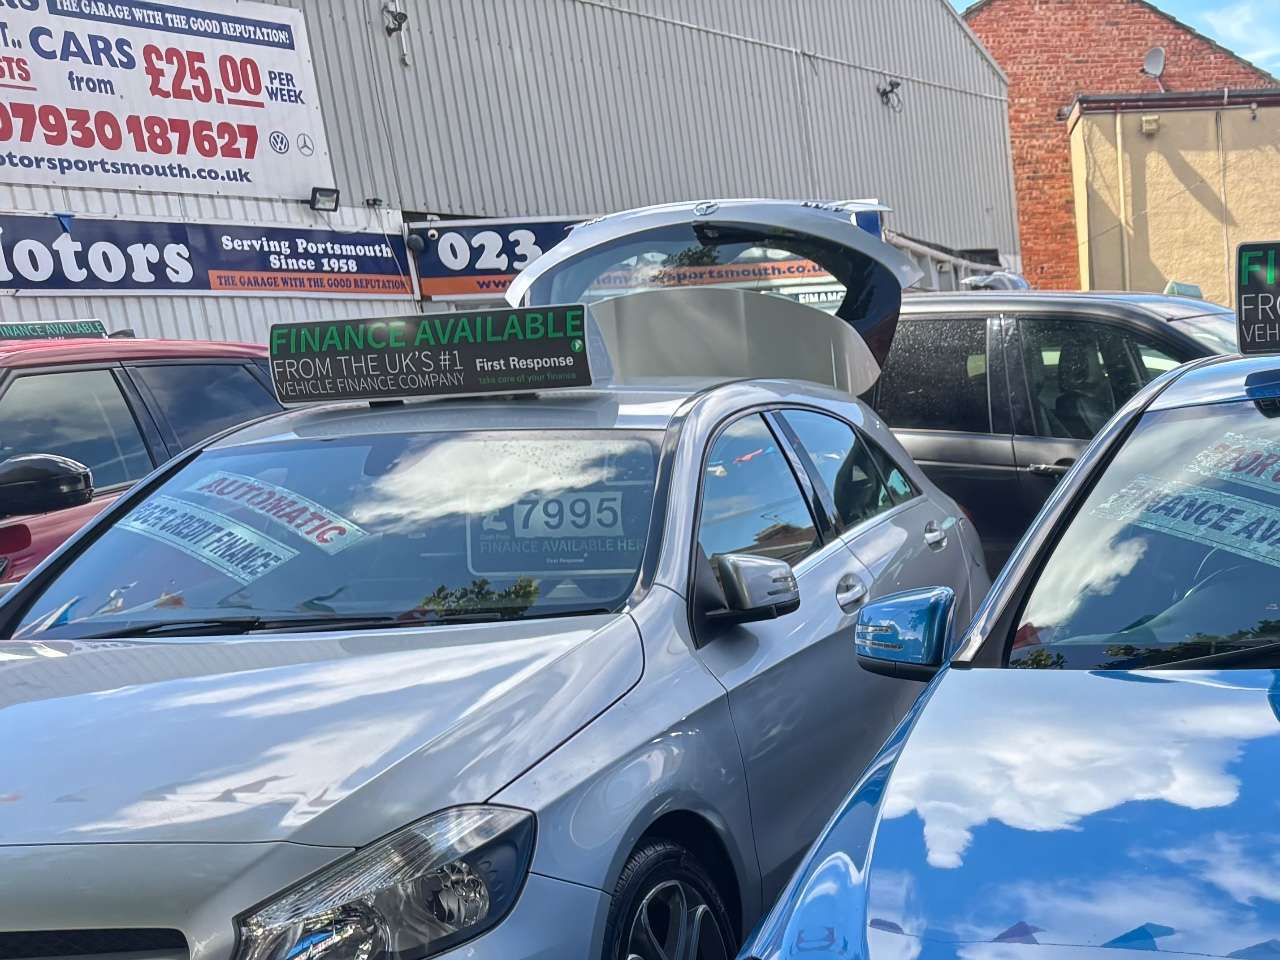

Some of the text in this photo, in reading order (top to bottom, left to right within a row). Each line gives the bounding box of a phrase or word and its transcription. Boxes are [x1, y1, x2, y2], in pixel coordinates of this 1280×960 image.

[56, 0, 80, 12] THE
[81, 1, 132, 20] GARAGE
[132, 7, 163, 25] WITH
[165, 13, 189, 29] THE
[189, 17, 220, 34] GOOD
[221, 21, 290, 44] REPUTATION!
[29, 26, 136, 70] CARS
[143, 44, 263, 103] £25.00
[68, 70, 115, 96] from
[268, 70, 295, 89] PER
[265, 86, 304, 104] WEEK
[126, 114, 259, 160] 187627
[0, 226, 194, 283] otors
[221, 235, 393, 259] Serving Portsmouth
[437, 230, 542, 271] 023
[269, 254, 358, 273] Since 1958
[216, 275, 237, 286] THE
[239, 275, 280, 288] GARAGE
[280, 277, 305, 288] WITH
[307, 277, 325, 289] THE
[327, 278, 352, 290] GOOD
[46, 321, 104, 335] AVAILABLE
[271, 310, 584, 354] FINANCE AVAILABLE
[273, 356, 333, 381] FROM
[336, 354, 380, 376] THE
[439, 350, 464, 371] #1
[475, 356, 574, 372] First Response
[277, 372, 465, 397] VEHICLE FINANCE COMPANY
[200, 477, 348, 545] AUTOMATIC
[161, 511, 225, 546] CREDIT
[202, 531, 283, 577] FINANCE
[479, 540, 539, 553] FINANCE
[542, 537, 614, 553] AVAILABLE
